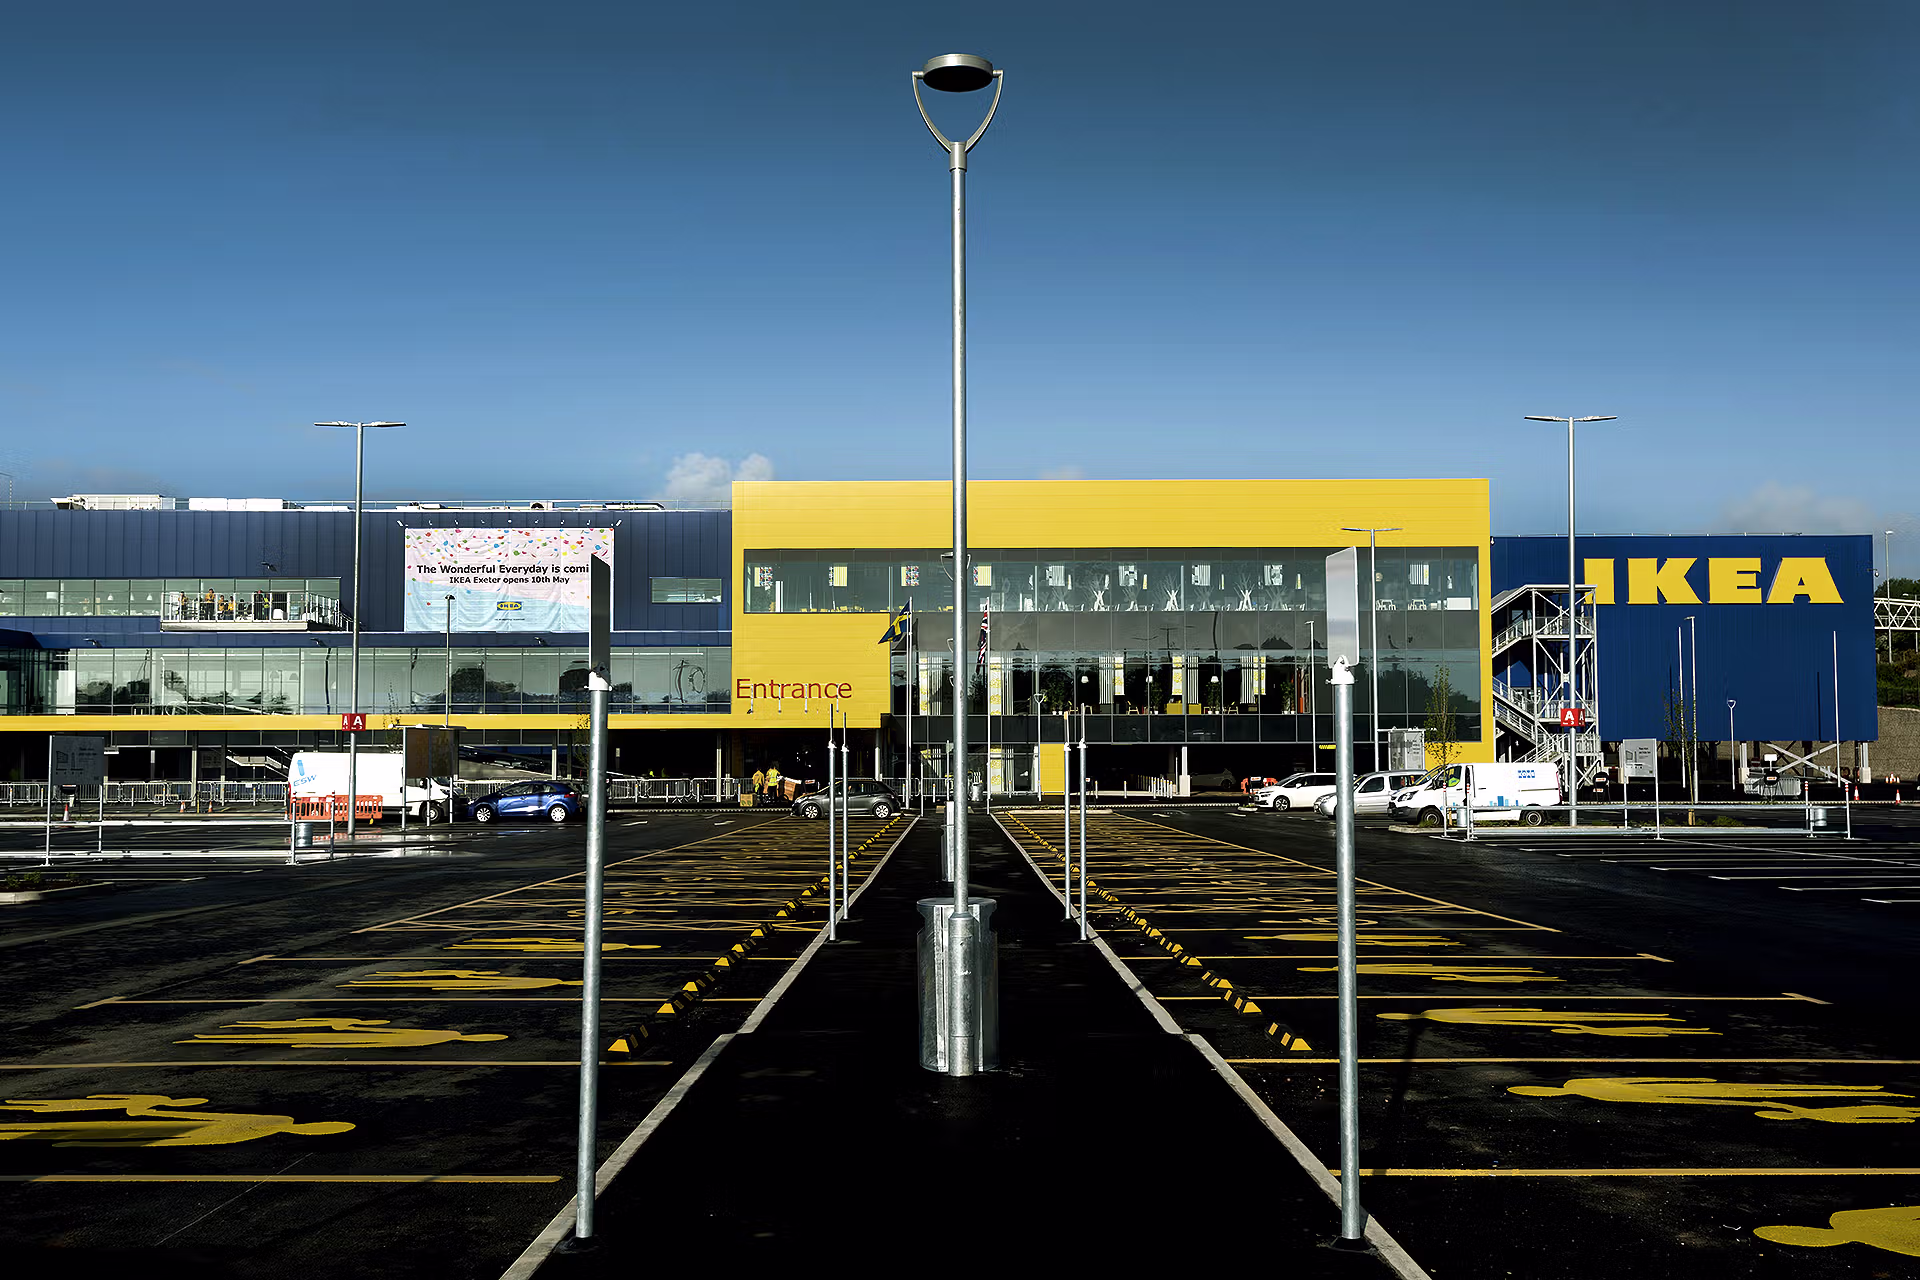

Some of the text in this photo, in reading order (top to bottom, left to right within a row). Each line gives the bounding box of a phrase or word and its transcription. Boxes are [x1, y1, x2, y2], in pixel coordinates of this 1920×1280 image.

[417, 564, 589, 575] The Wonderful Everyday is comi
[552, 576, 570, 584] May
[1584, 557, 1844, 604] IKEA
[736, 678, 852, 699] Entrance
[1564, 710, 1574, 720] A
[1580, 710, 1584, 720] A
[343, 716, 348, 725] A
[353, 716, 362, 725] A
